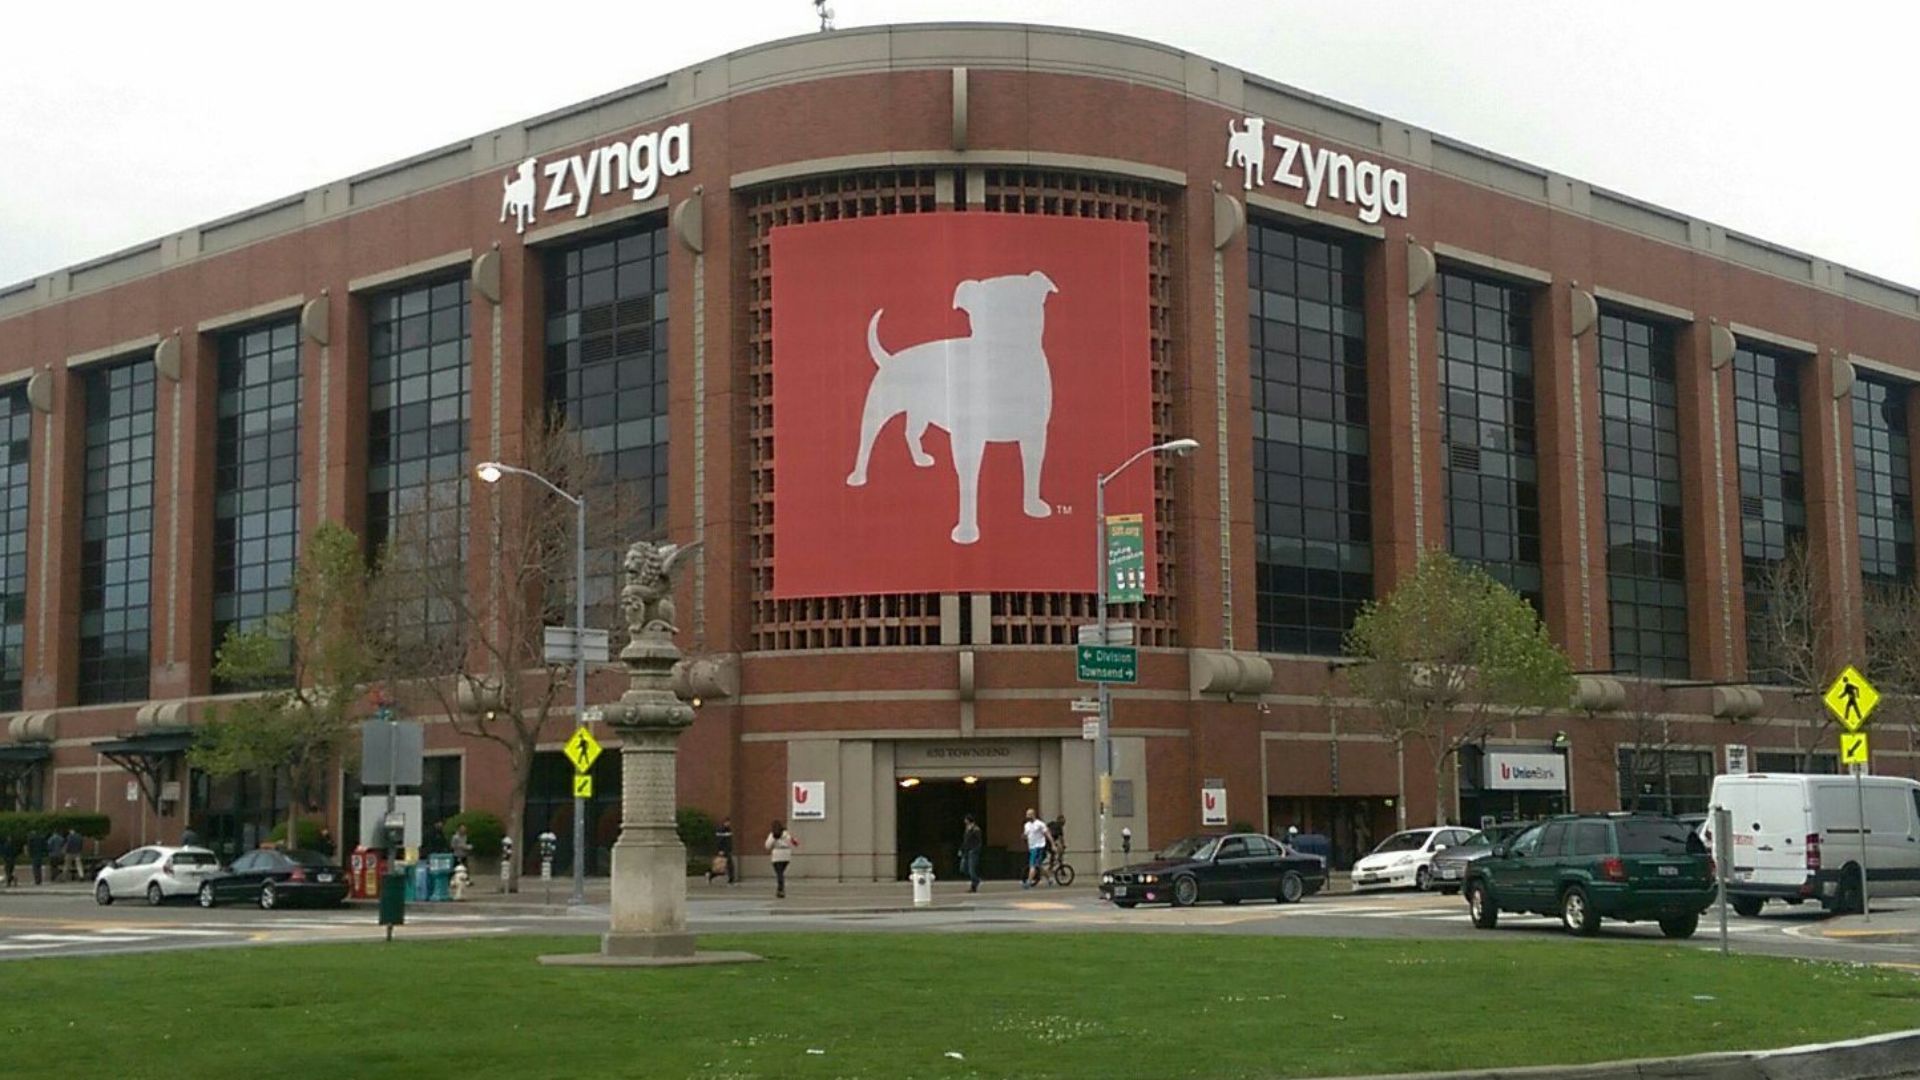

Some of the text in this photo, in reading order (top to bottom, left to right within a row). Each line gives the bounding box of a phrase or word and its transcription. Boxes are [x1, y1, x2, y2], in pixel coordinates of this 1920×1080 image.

[543, 122, 690, 217] zynga
[1272, 134, 1408, 224] zynga
[1056, 504, 1073, 514] TM
[1096, 649, 1132, 662] Division
[1080, 664, 1123, 678] Townsend
